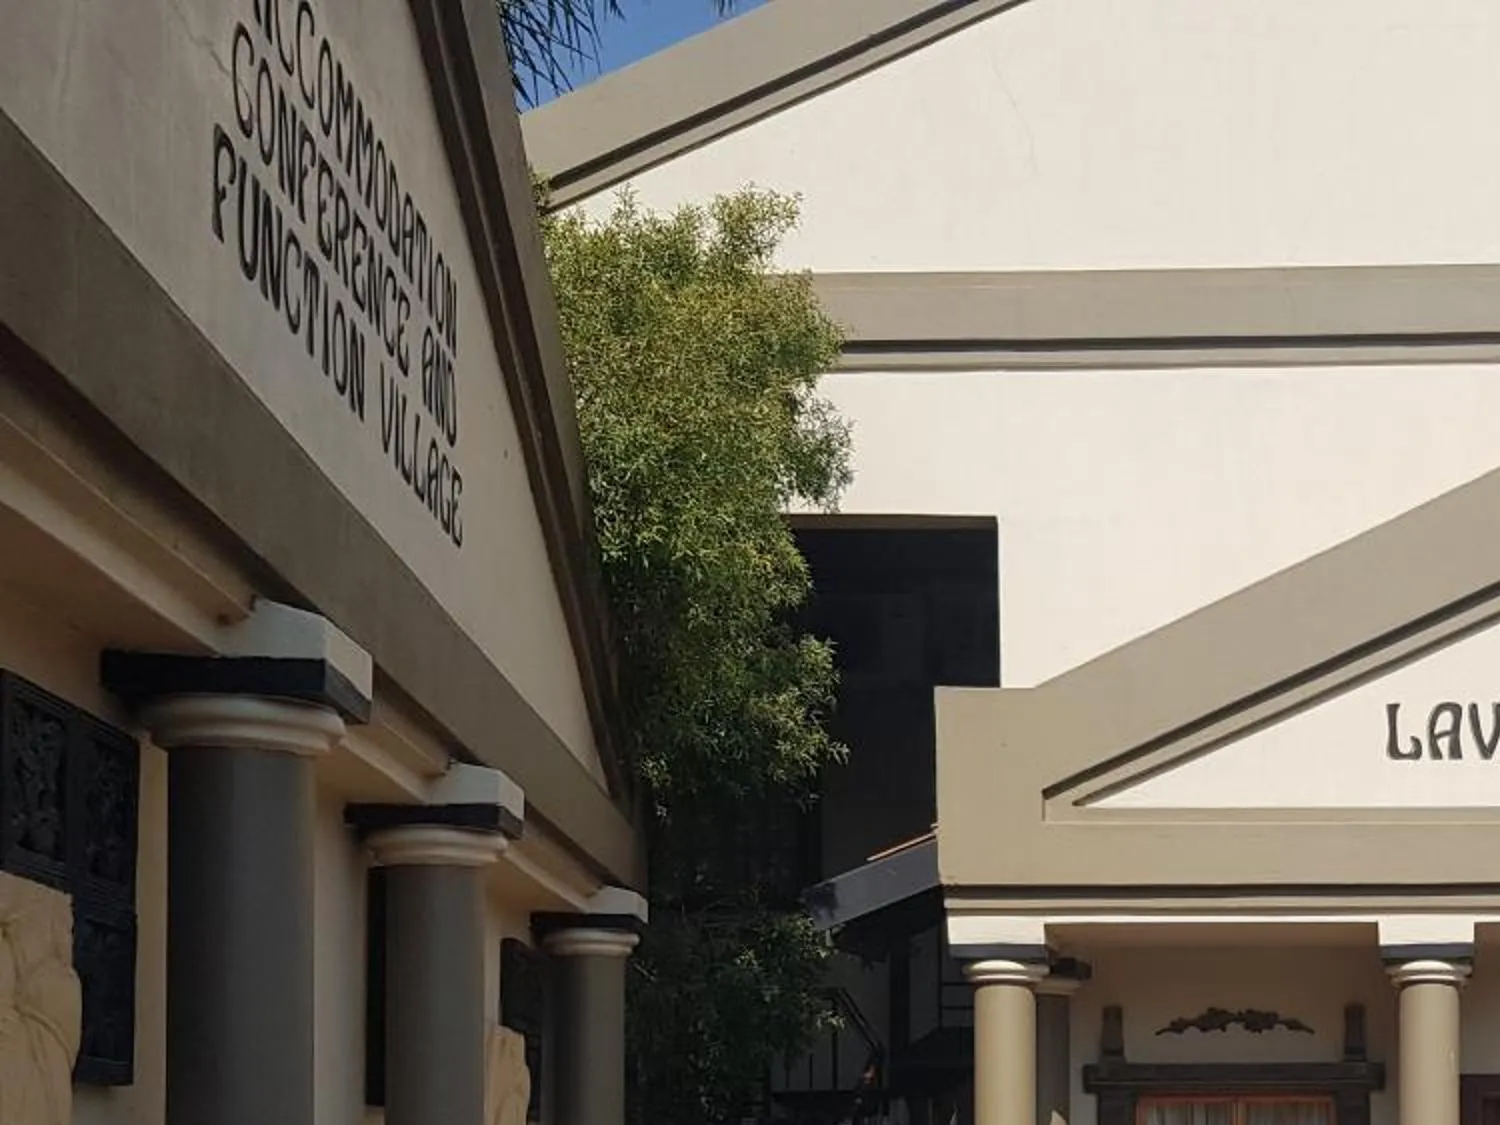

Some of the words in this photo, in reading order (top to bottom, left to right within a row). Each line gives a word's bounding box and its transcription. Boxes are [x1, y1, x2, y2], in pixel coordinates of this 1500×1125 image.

[211, 123, 366, 423] FUNCTION
[380, 360, 463, 549] VILLAGE
[232, 21, 410, 377] CONFERENCE
[422, 326, 457, 448] AND
